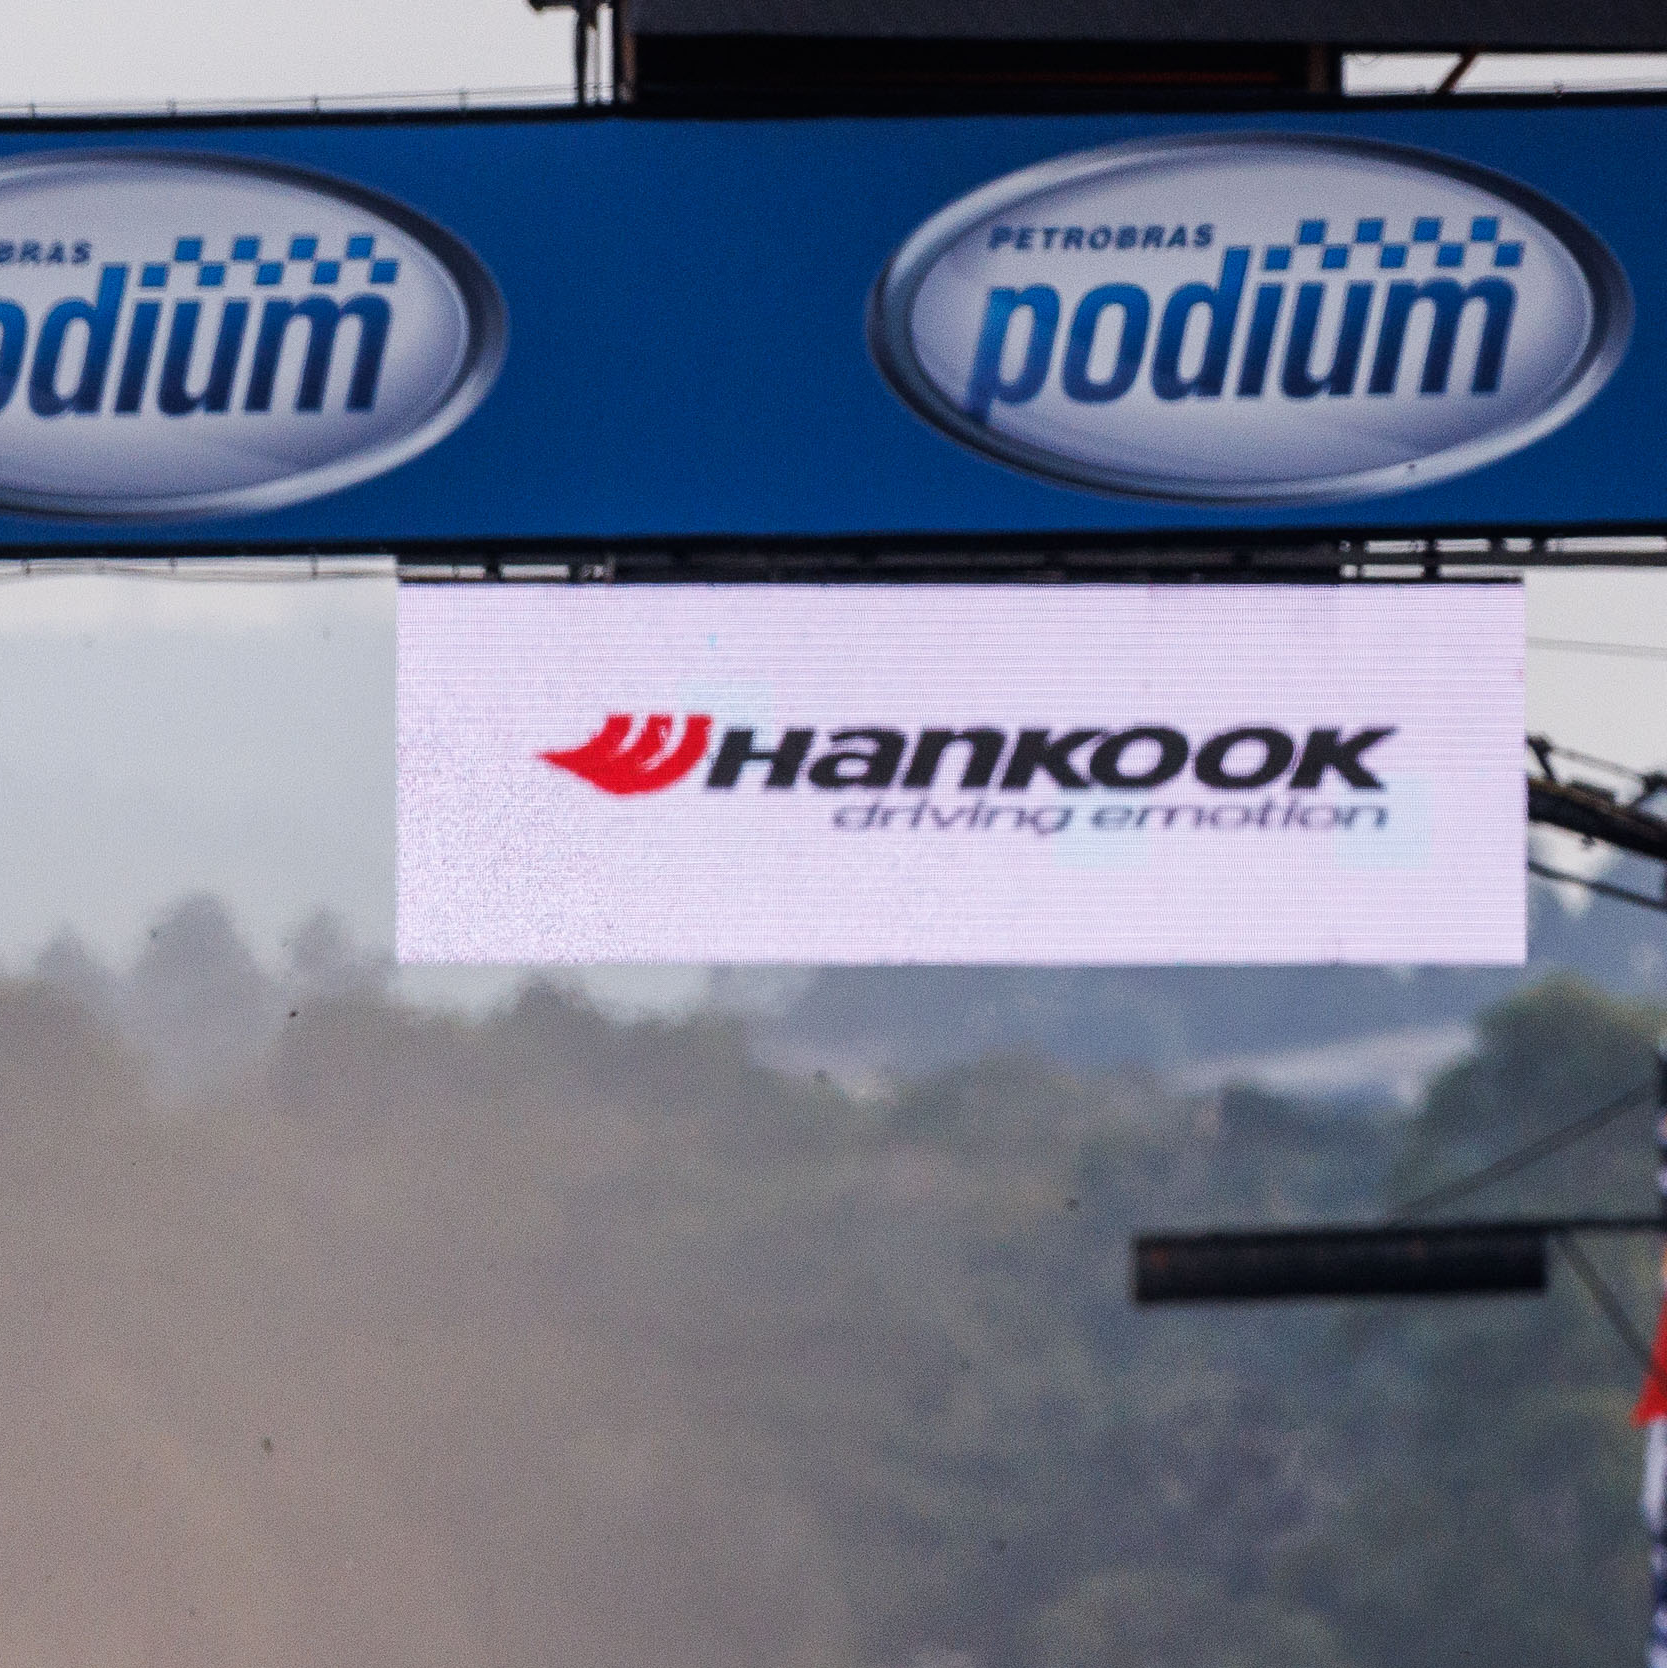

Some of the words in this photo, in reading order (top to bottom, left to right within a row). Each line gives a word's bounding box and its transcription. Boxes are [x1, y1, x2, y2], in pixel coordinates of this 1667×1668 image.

[988, 225, 1212, 252] PETROBRAS
[967, 246, 1518, 419] podium
[833, 798, 1069, 834] driving
[1091, 797, 1389, 831] emotion
